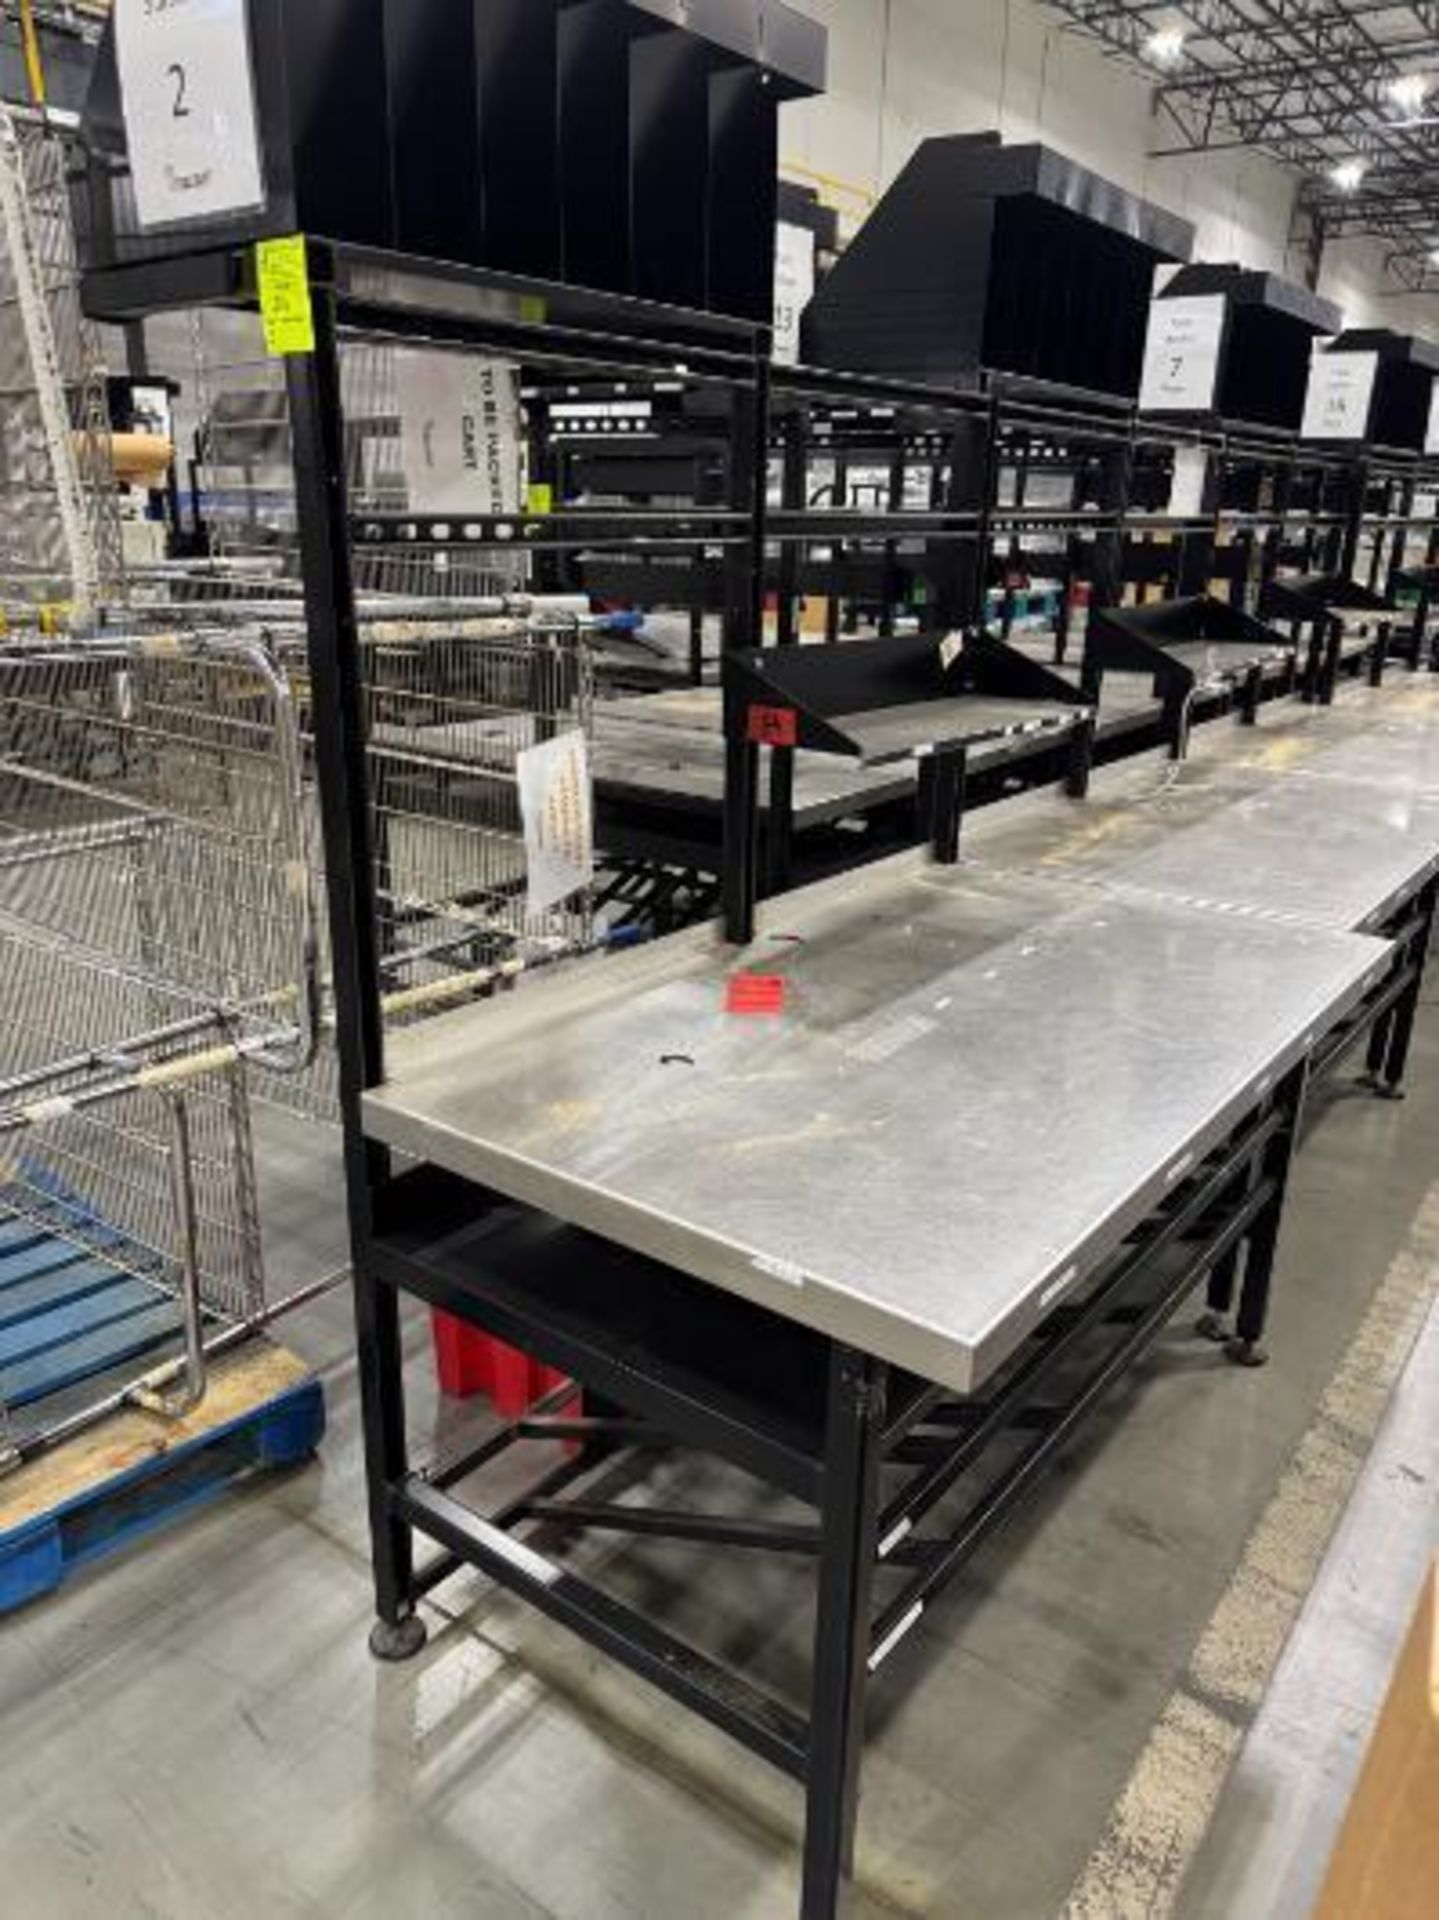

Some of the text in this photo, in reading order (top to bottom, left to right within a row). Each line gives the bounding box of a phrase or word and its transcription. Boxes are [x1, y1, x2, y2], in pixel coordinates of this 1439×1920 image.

[168, 63, 190, 117] 2
[480, 367, 494, 396] TO
[483, 400, 497, 427] BE
[461, 415, 478, 470] CART
